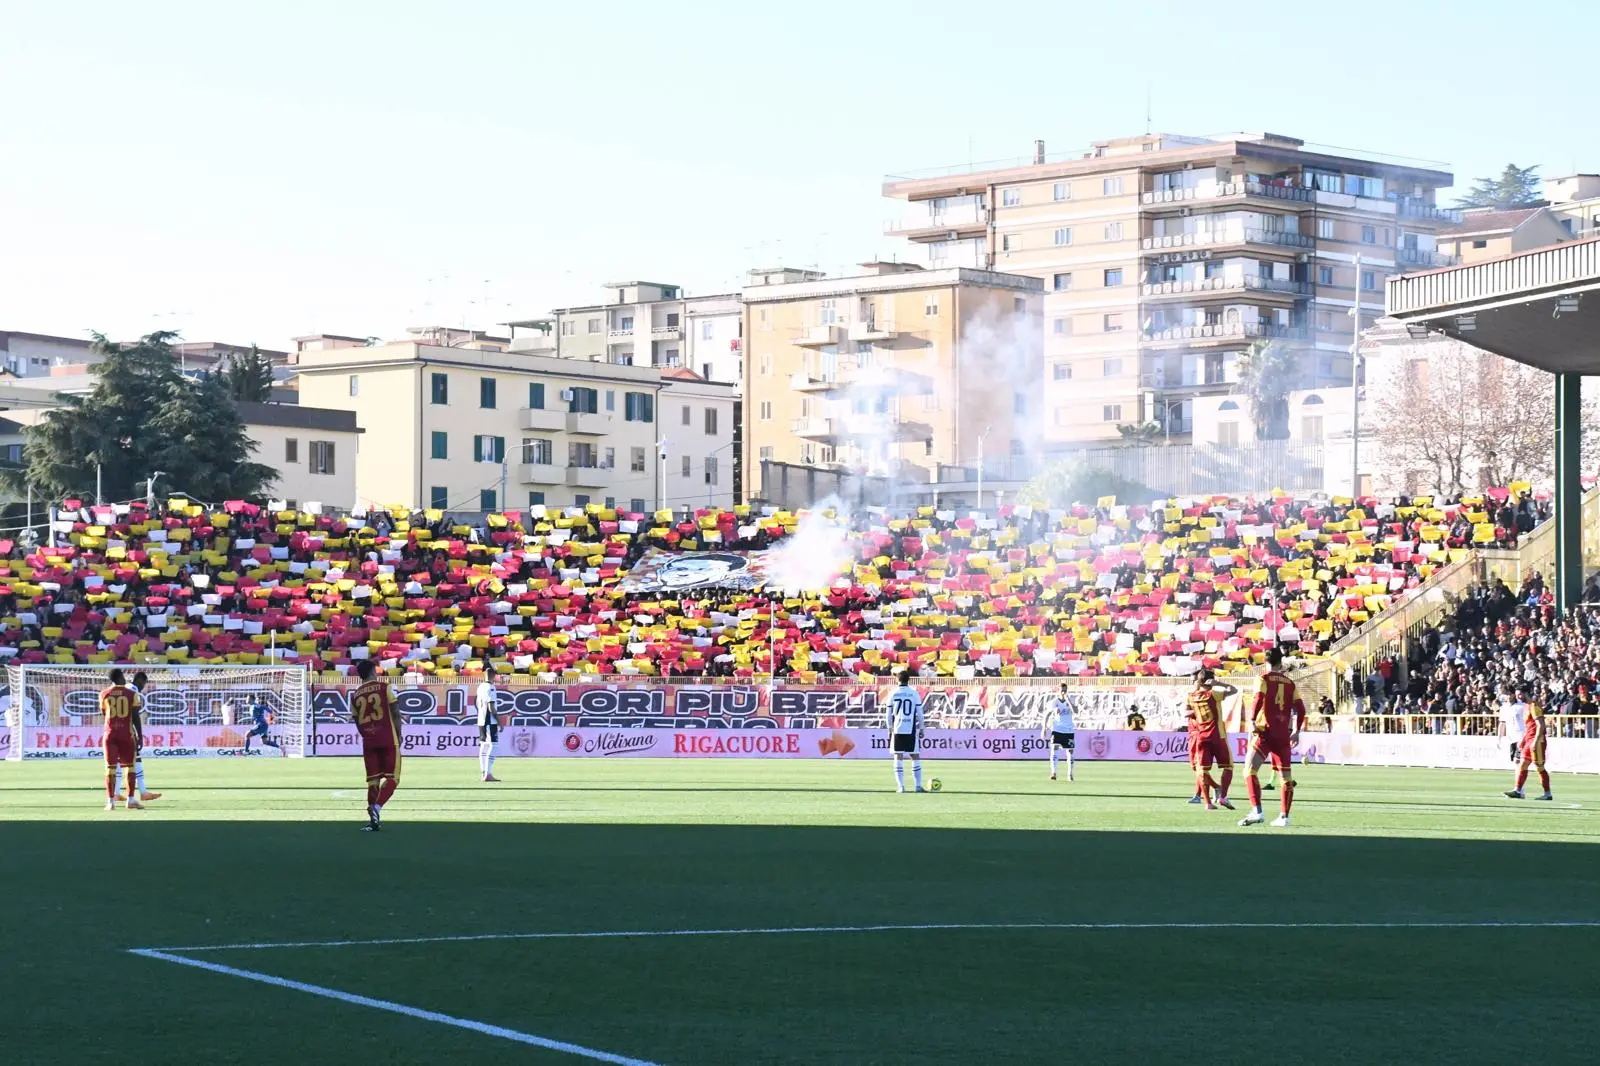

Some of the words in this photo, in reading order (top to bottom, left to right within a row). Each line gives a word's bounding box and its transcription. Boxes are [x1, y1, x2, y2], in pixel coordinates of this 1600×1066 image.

[356, 693, 384, 724] 23
[447, 689, 465, 715] I
[676, 685, 759, 716] PIÙ
[893, 698, 912, 716] 70
[1275, 683, 1285, 711] 4
[674, 733, 800, 754] RIGACUORE
[982, 735, 1017, 753] ogni
